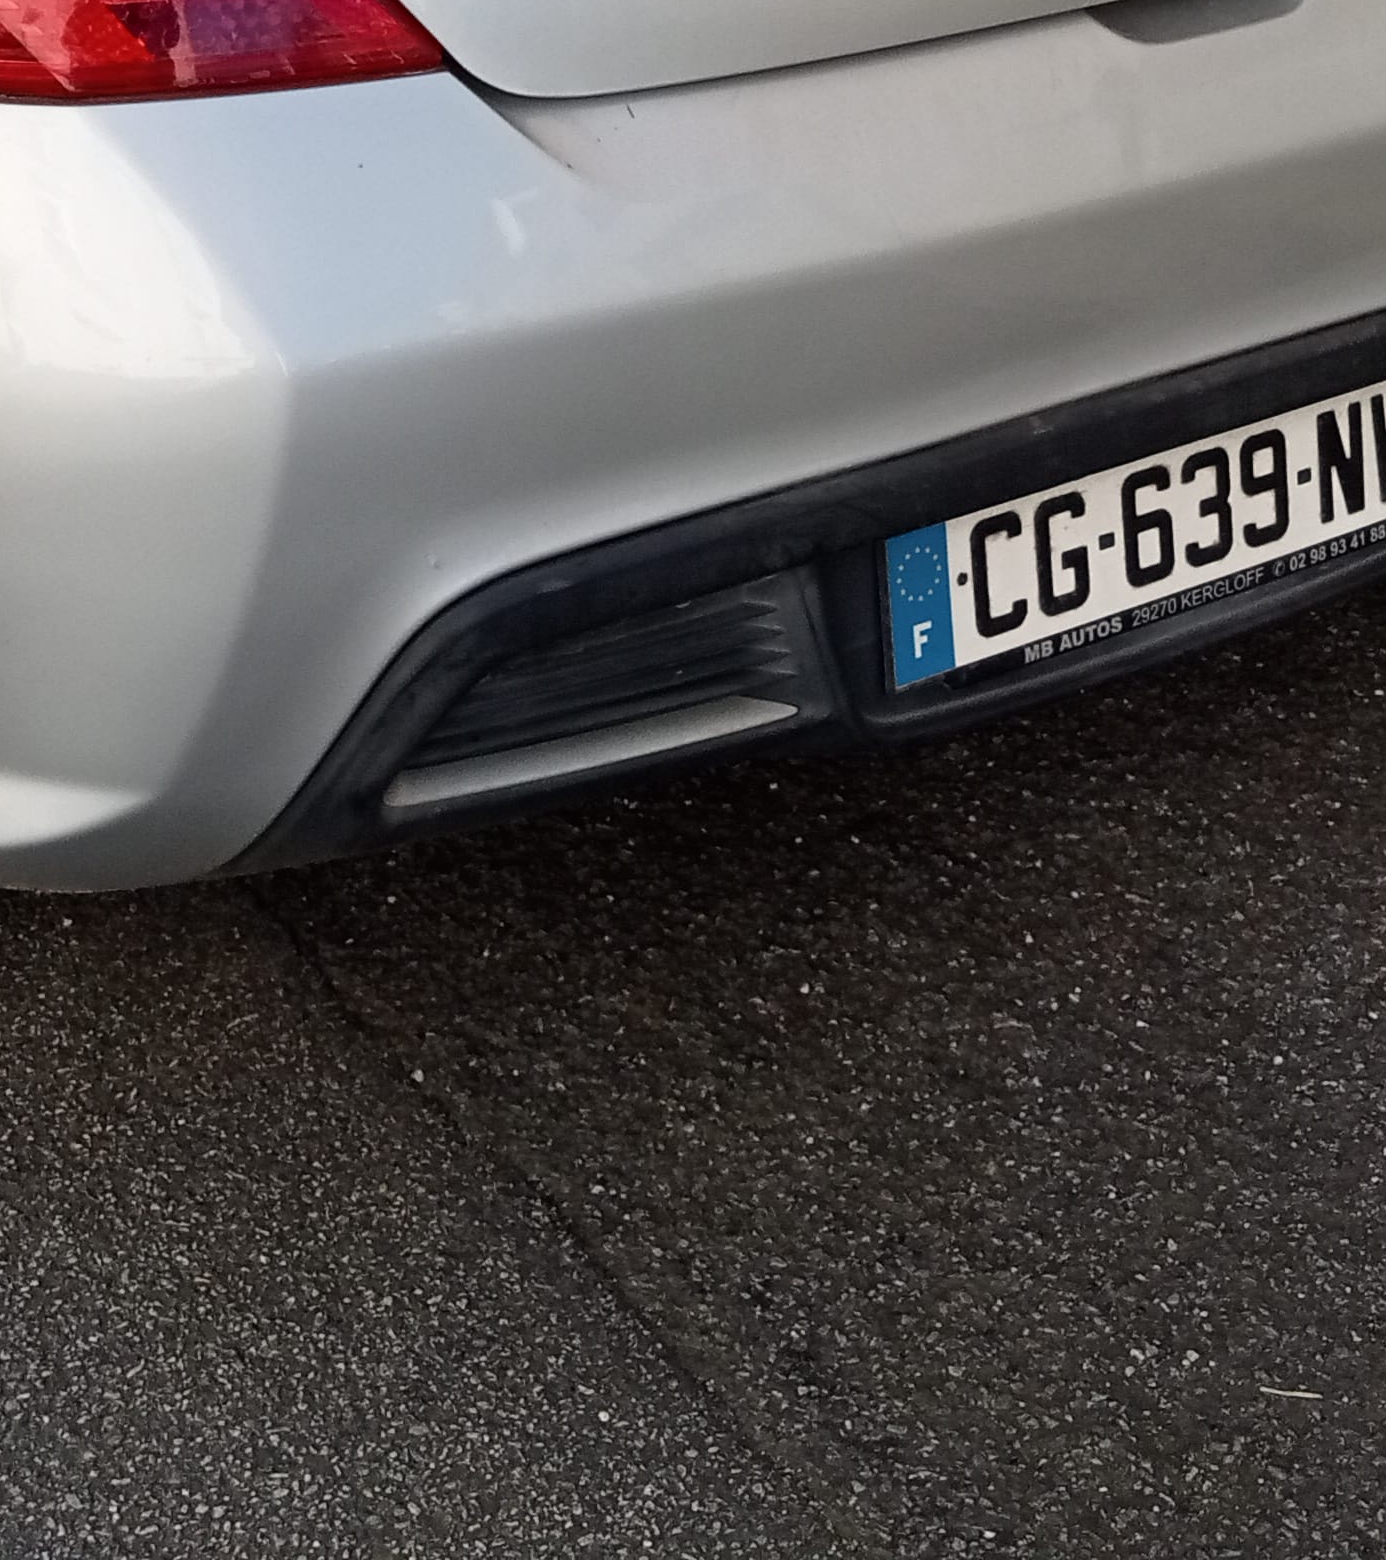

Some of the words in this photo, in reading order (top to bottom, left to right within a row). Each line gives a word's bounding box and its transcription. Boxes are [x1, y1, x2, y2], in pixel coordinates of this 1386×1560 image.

[913, 620, 933, 659] F
[1024, 640, 1054, 665] MB
[1059, 616, 1124, 653] AUTOS
[1132, 598, 1177, 628] 29270
[1181, 567, 1266, 611] KERGLOFF
[1289, 553, 1307, 572] 02
[1310, 546, 1327, 565] 98
[1330, 538, 1348, 558] 93
[1350, 531, 1366, 549] 41
